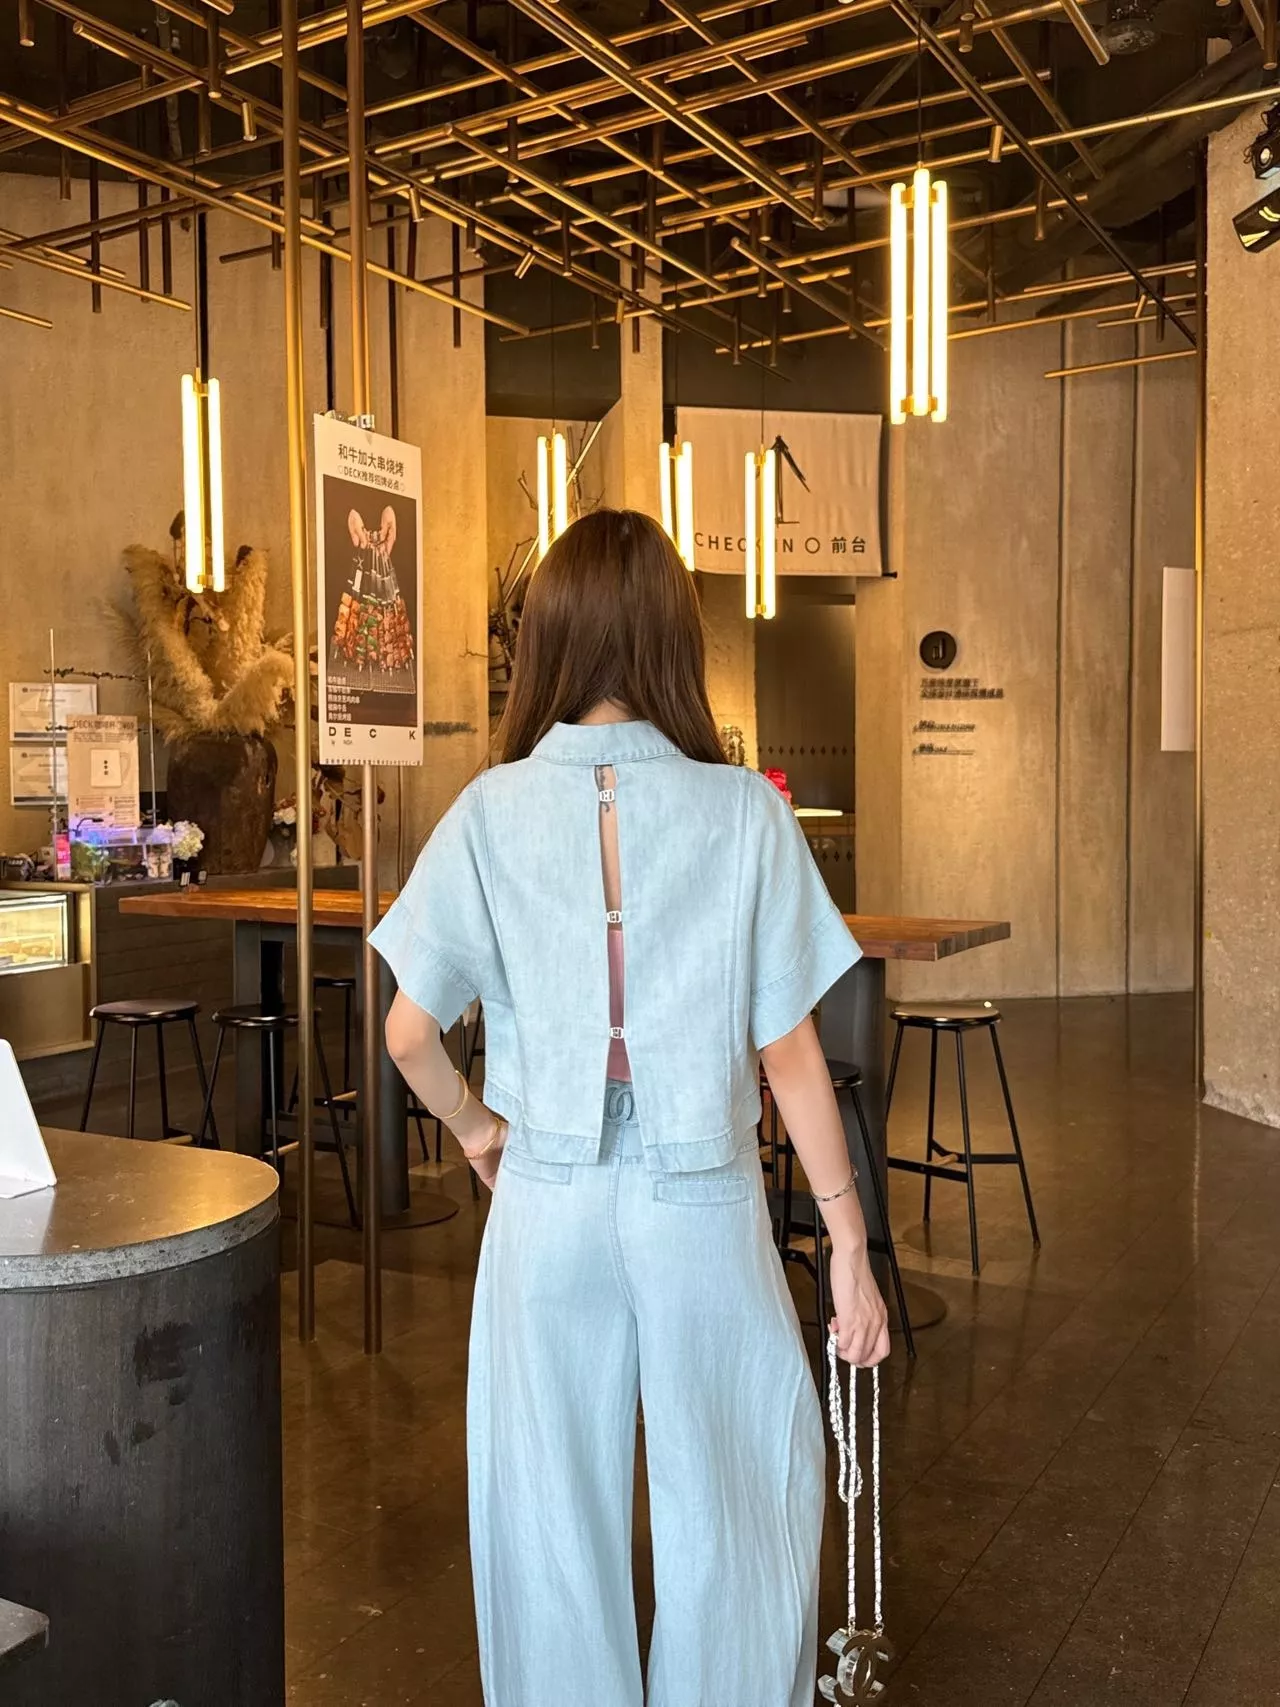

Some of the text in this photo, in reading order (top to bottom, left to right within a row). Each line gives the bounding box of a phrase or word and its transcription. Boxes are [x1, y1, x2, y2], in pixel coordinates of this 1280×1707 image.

[338, 443, 404, 477] 和牛加大串烧烤
[831, 536, 866, 554] 前台
